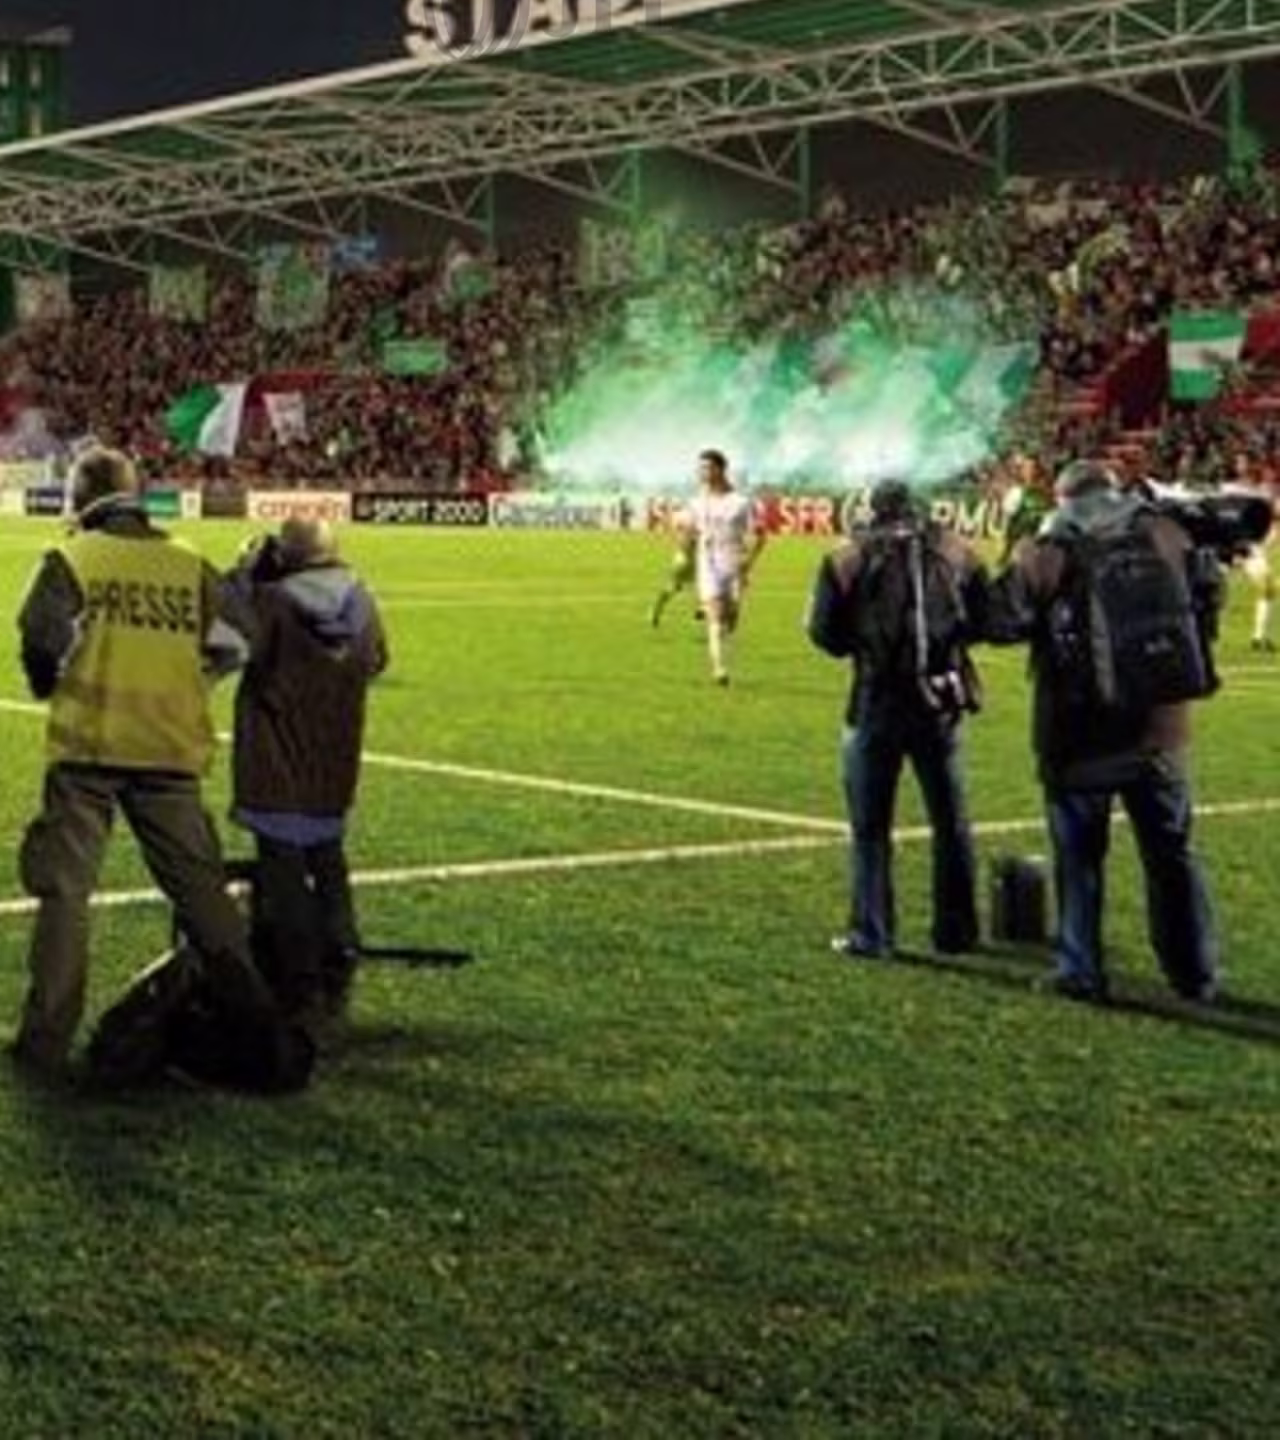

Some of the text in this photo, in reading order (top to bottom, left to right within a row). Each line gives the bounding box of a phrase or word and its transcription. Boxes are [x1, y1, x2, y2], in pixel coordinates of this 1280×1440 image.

[373, 500, 486, 523] SPORT 2000
[779, 496, 835, 536] SFR
[88, 579, 198, 634] PRESSE
